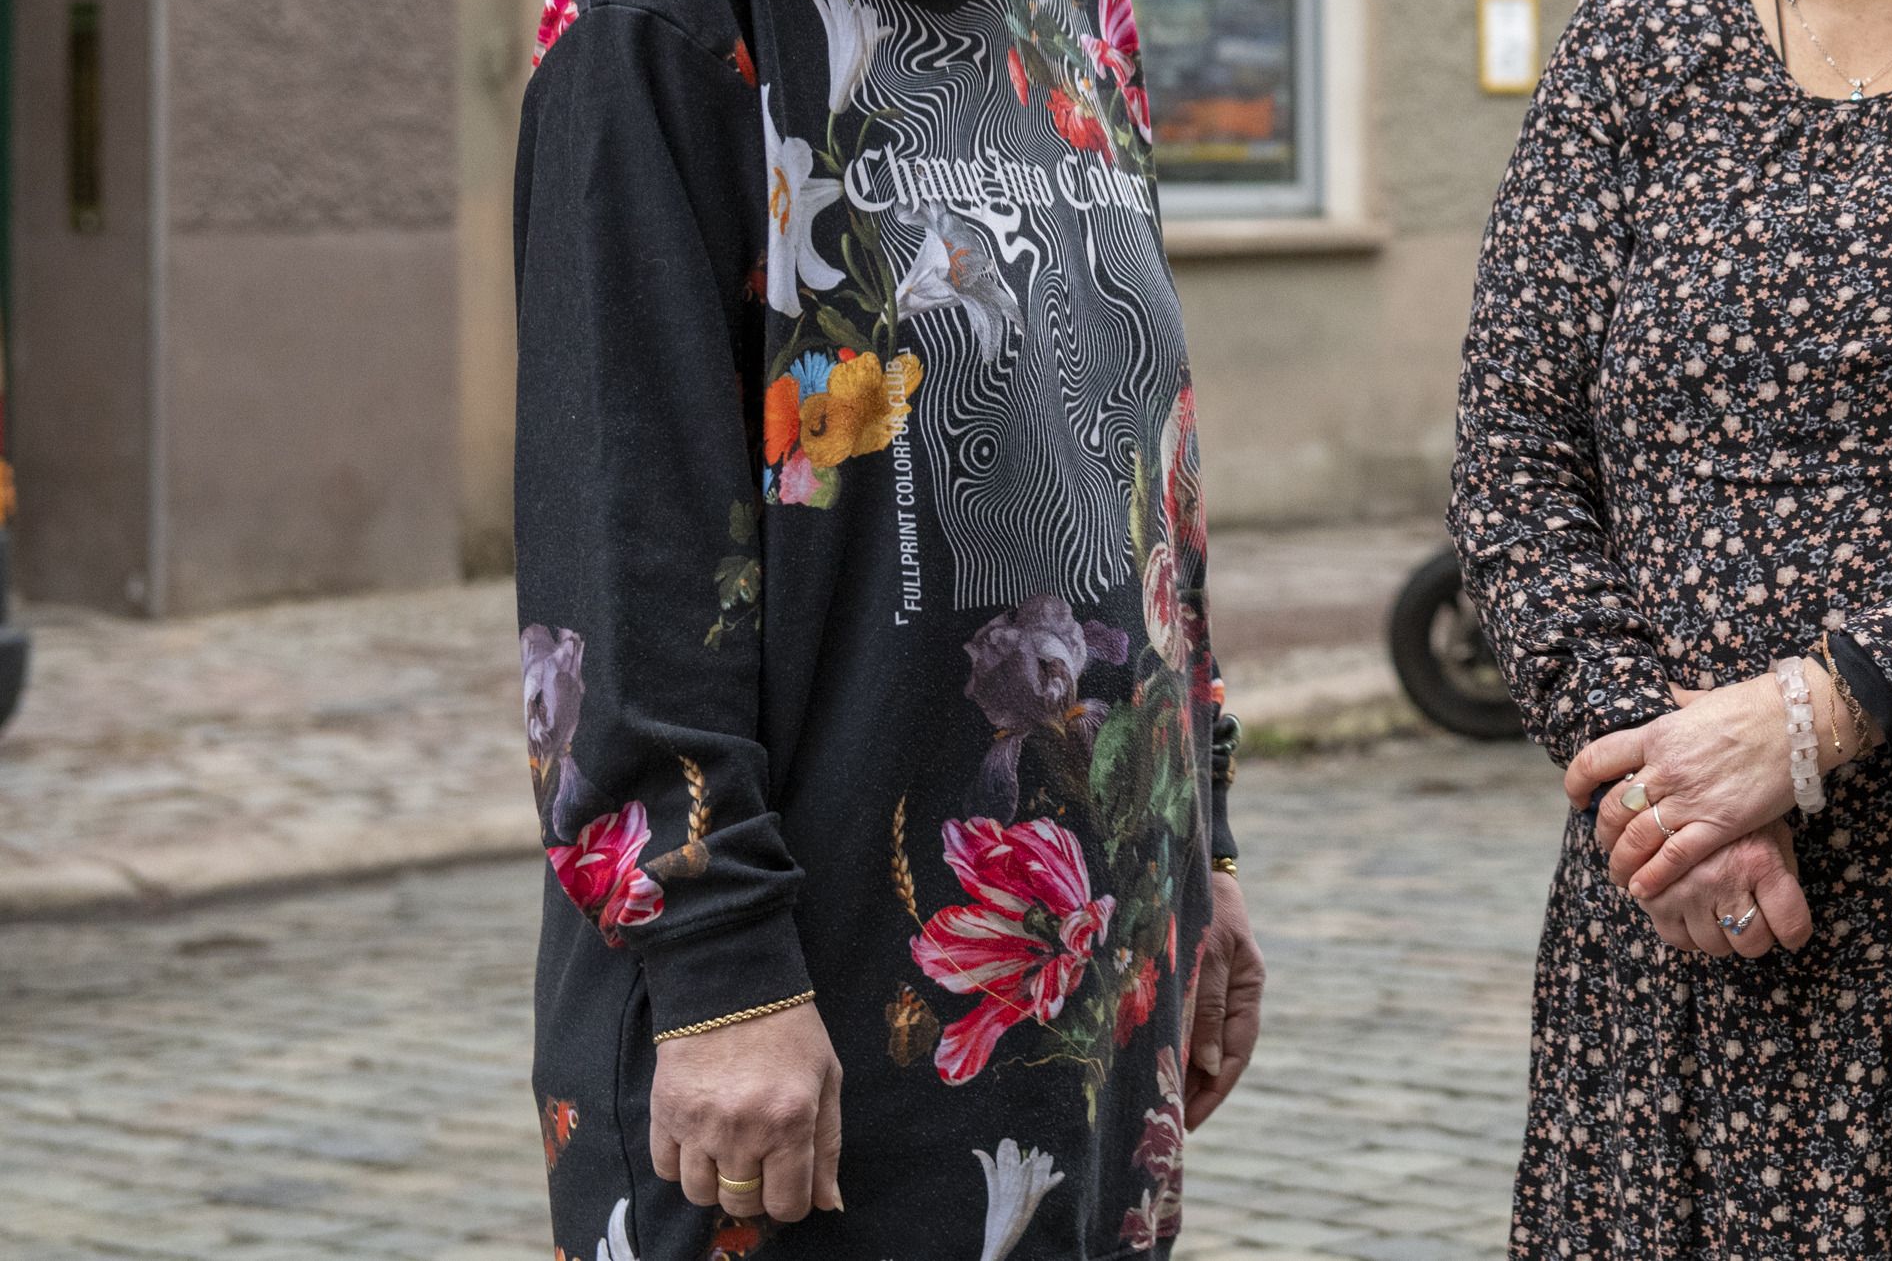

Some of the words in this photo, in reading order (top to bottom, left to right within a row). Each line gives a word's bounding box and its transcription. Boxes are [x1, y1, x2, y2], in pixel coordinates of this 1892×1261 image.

[844, 141, 992, 216] Change
[985, 146, 1055, 208] Into
[886, 360, 906, 408] CLUB
[892, 414, 915, 506] COLORFUL
[898, 509, 922, 612] FULLPRINT
